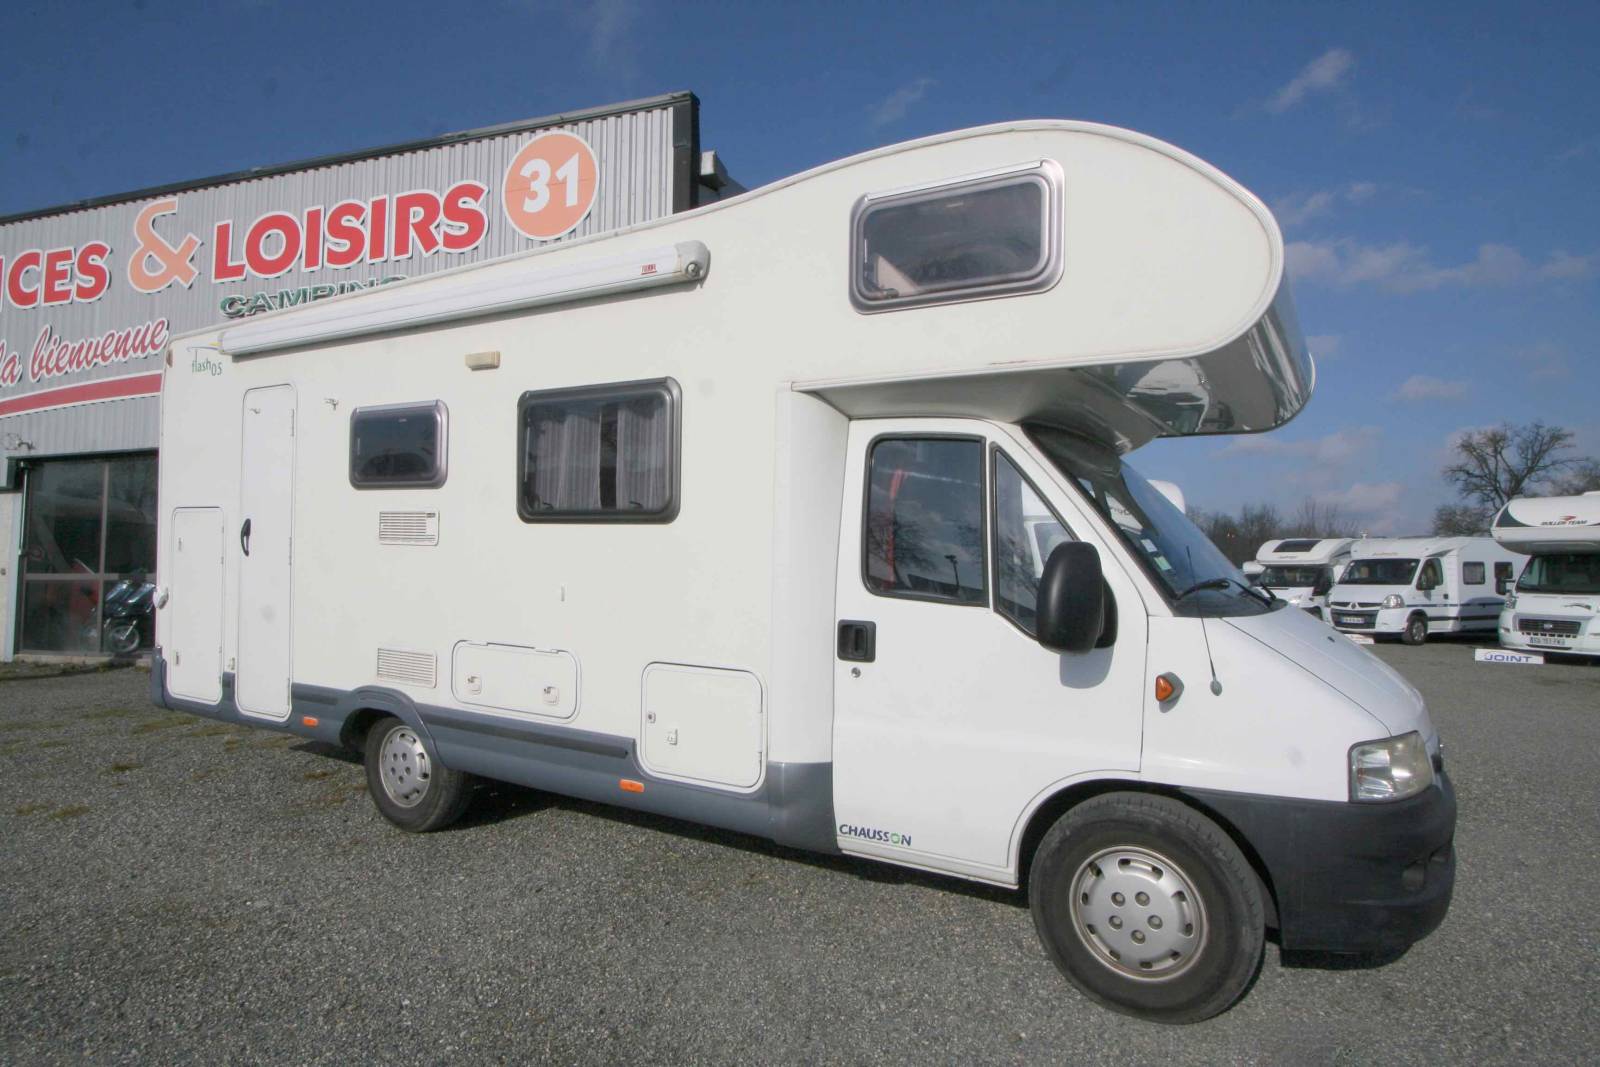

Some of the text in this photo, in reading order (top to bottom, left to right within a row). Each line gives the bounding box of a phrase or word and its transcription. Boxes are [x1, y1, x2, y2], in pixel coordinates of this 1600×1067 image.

[519, 152, 581, 214] 31
[128, 199, 201, 294] &
[212, 179, 489, 284] LOISIRS
[29, 317, 169, 384] bienvenue
[839, 823, 912, 847] CHAUSSON
